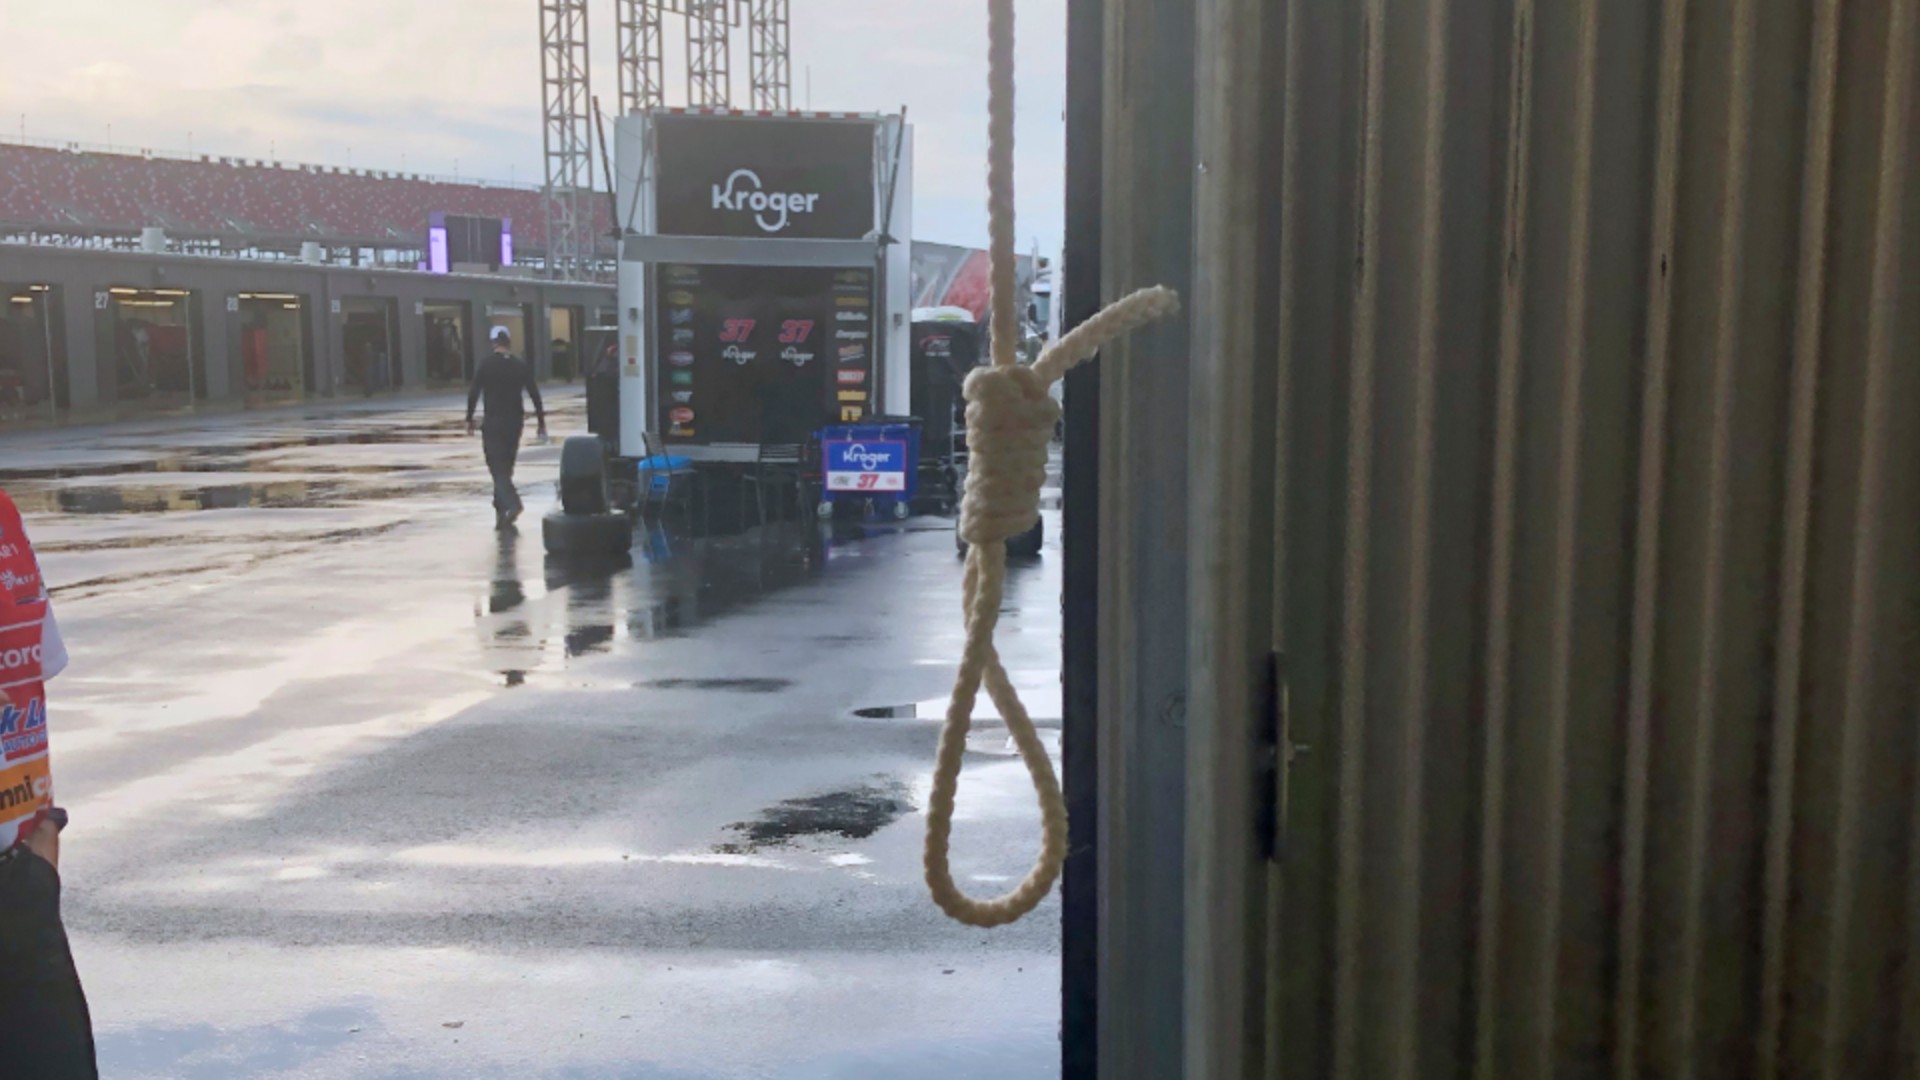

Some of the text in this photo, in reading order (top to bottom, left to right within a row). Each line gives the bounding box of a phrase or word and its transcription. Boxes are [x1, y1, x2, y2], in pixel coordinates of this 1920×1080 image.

[712, 168, 819, 231] Kroger
[95, 291, 109, 310] 27
[719, 318, 757, 343] 37
[777, 319, 816, 344] 37
[842, 443, 891, 471] Kroger
[856, 473, 880, 489] 37
